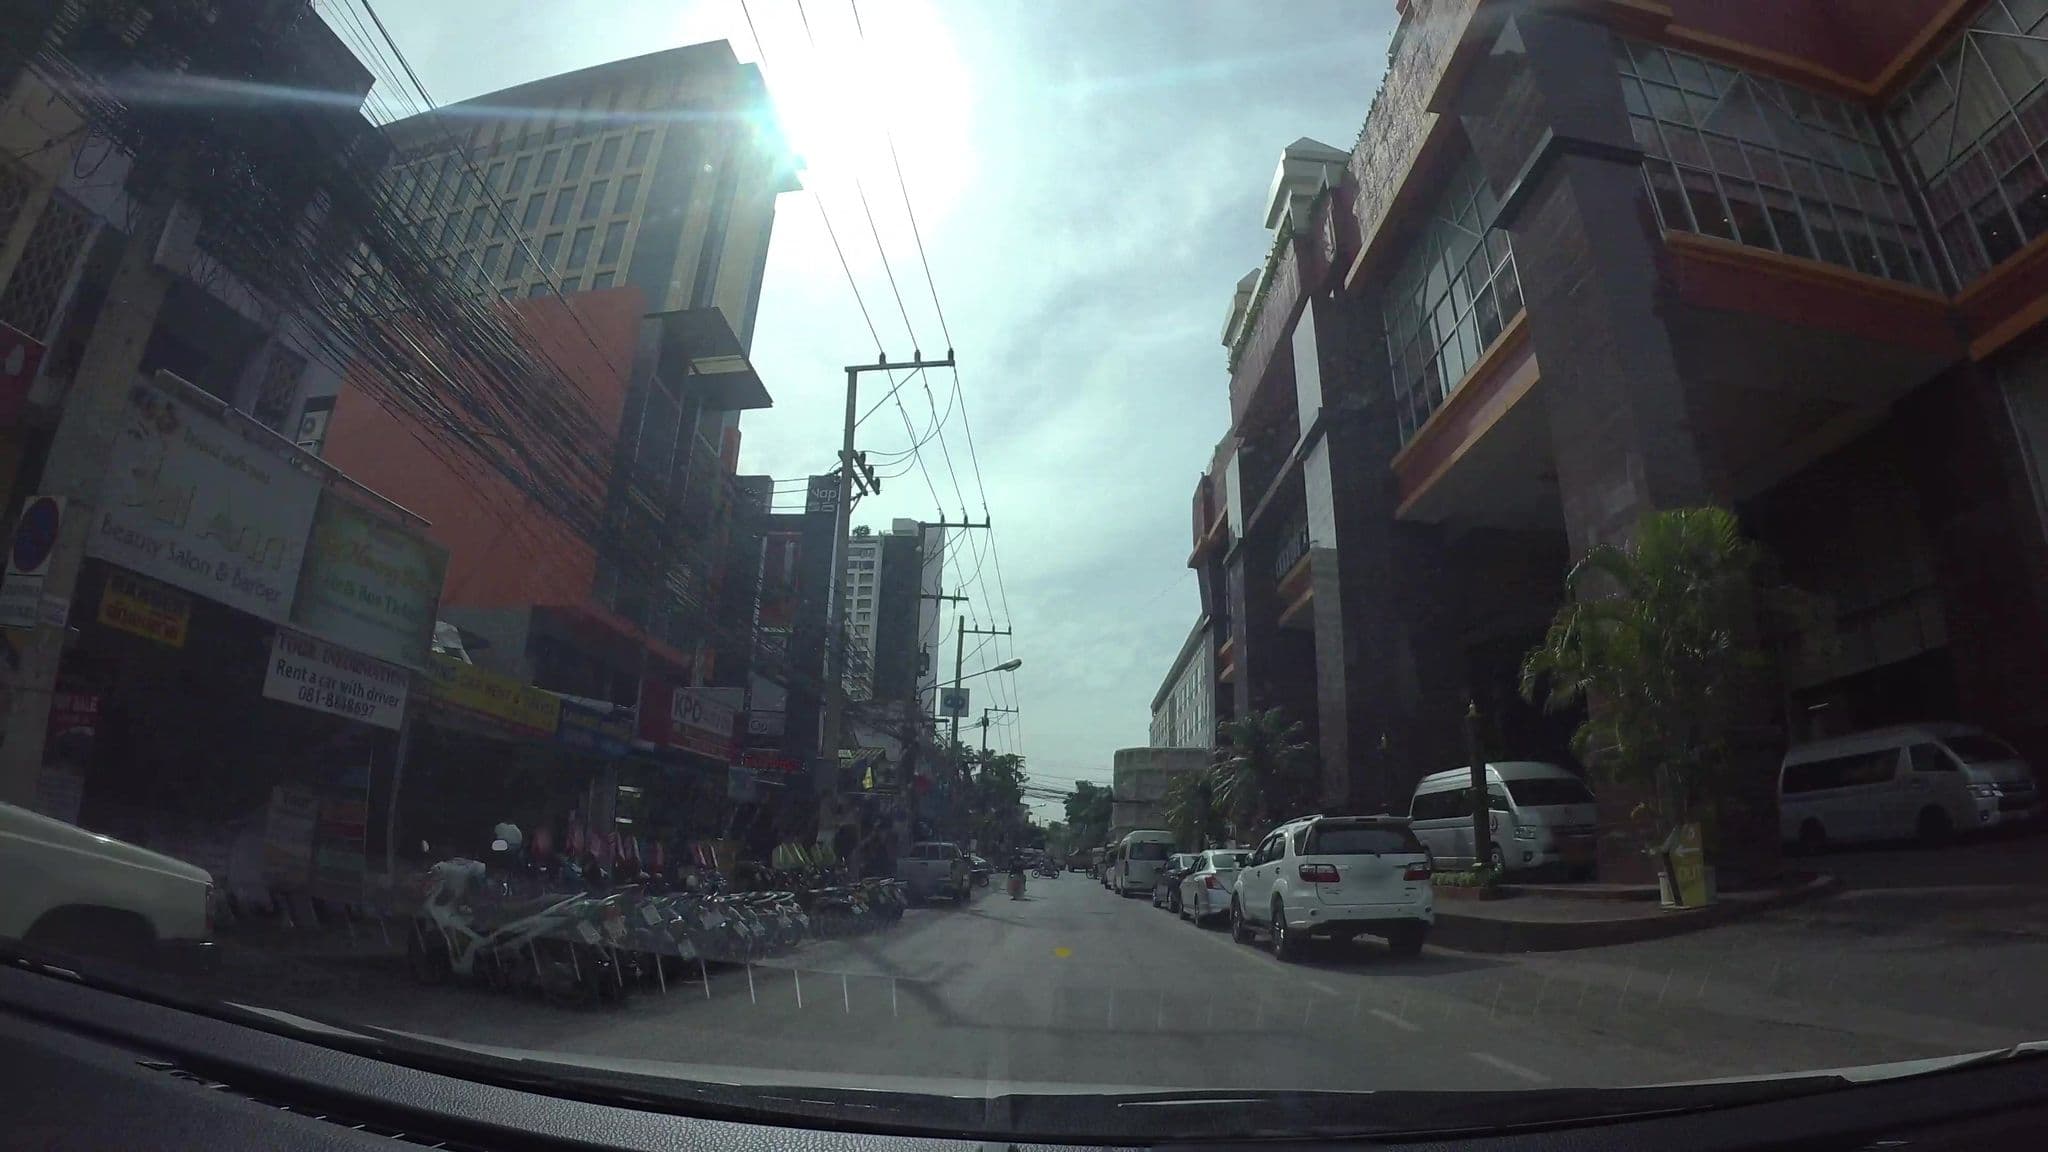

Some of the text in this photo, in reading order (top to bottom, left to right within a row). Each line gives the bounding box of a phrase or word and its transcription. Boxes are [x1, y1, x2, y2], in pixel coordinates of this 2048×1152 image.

[101, 511, 161, 558] Beauty
[169, 542, 210, 576] Salon
[216, 561, 229, 583] &
[231, 568, 281, 602] Barber
[276, 659, 400, 708] Rent a car with driver
